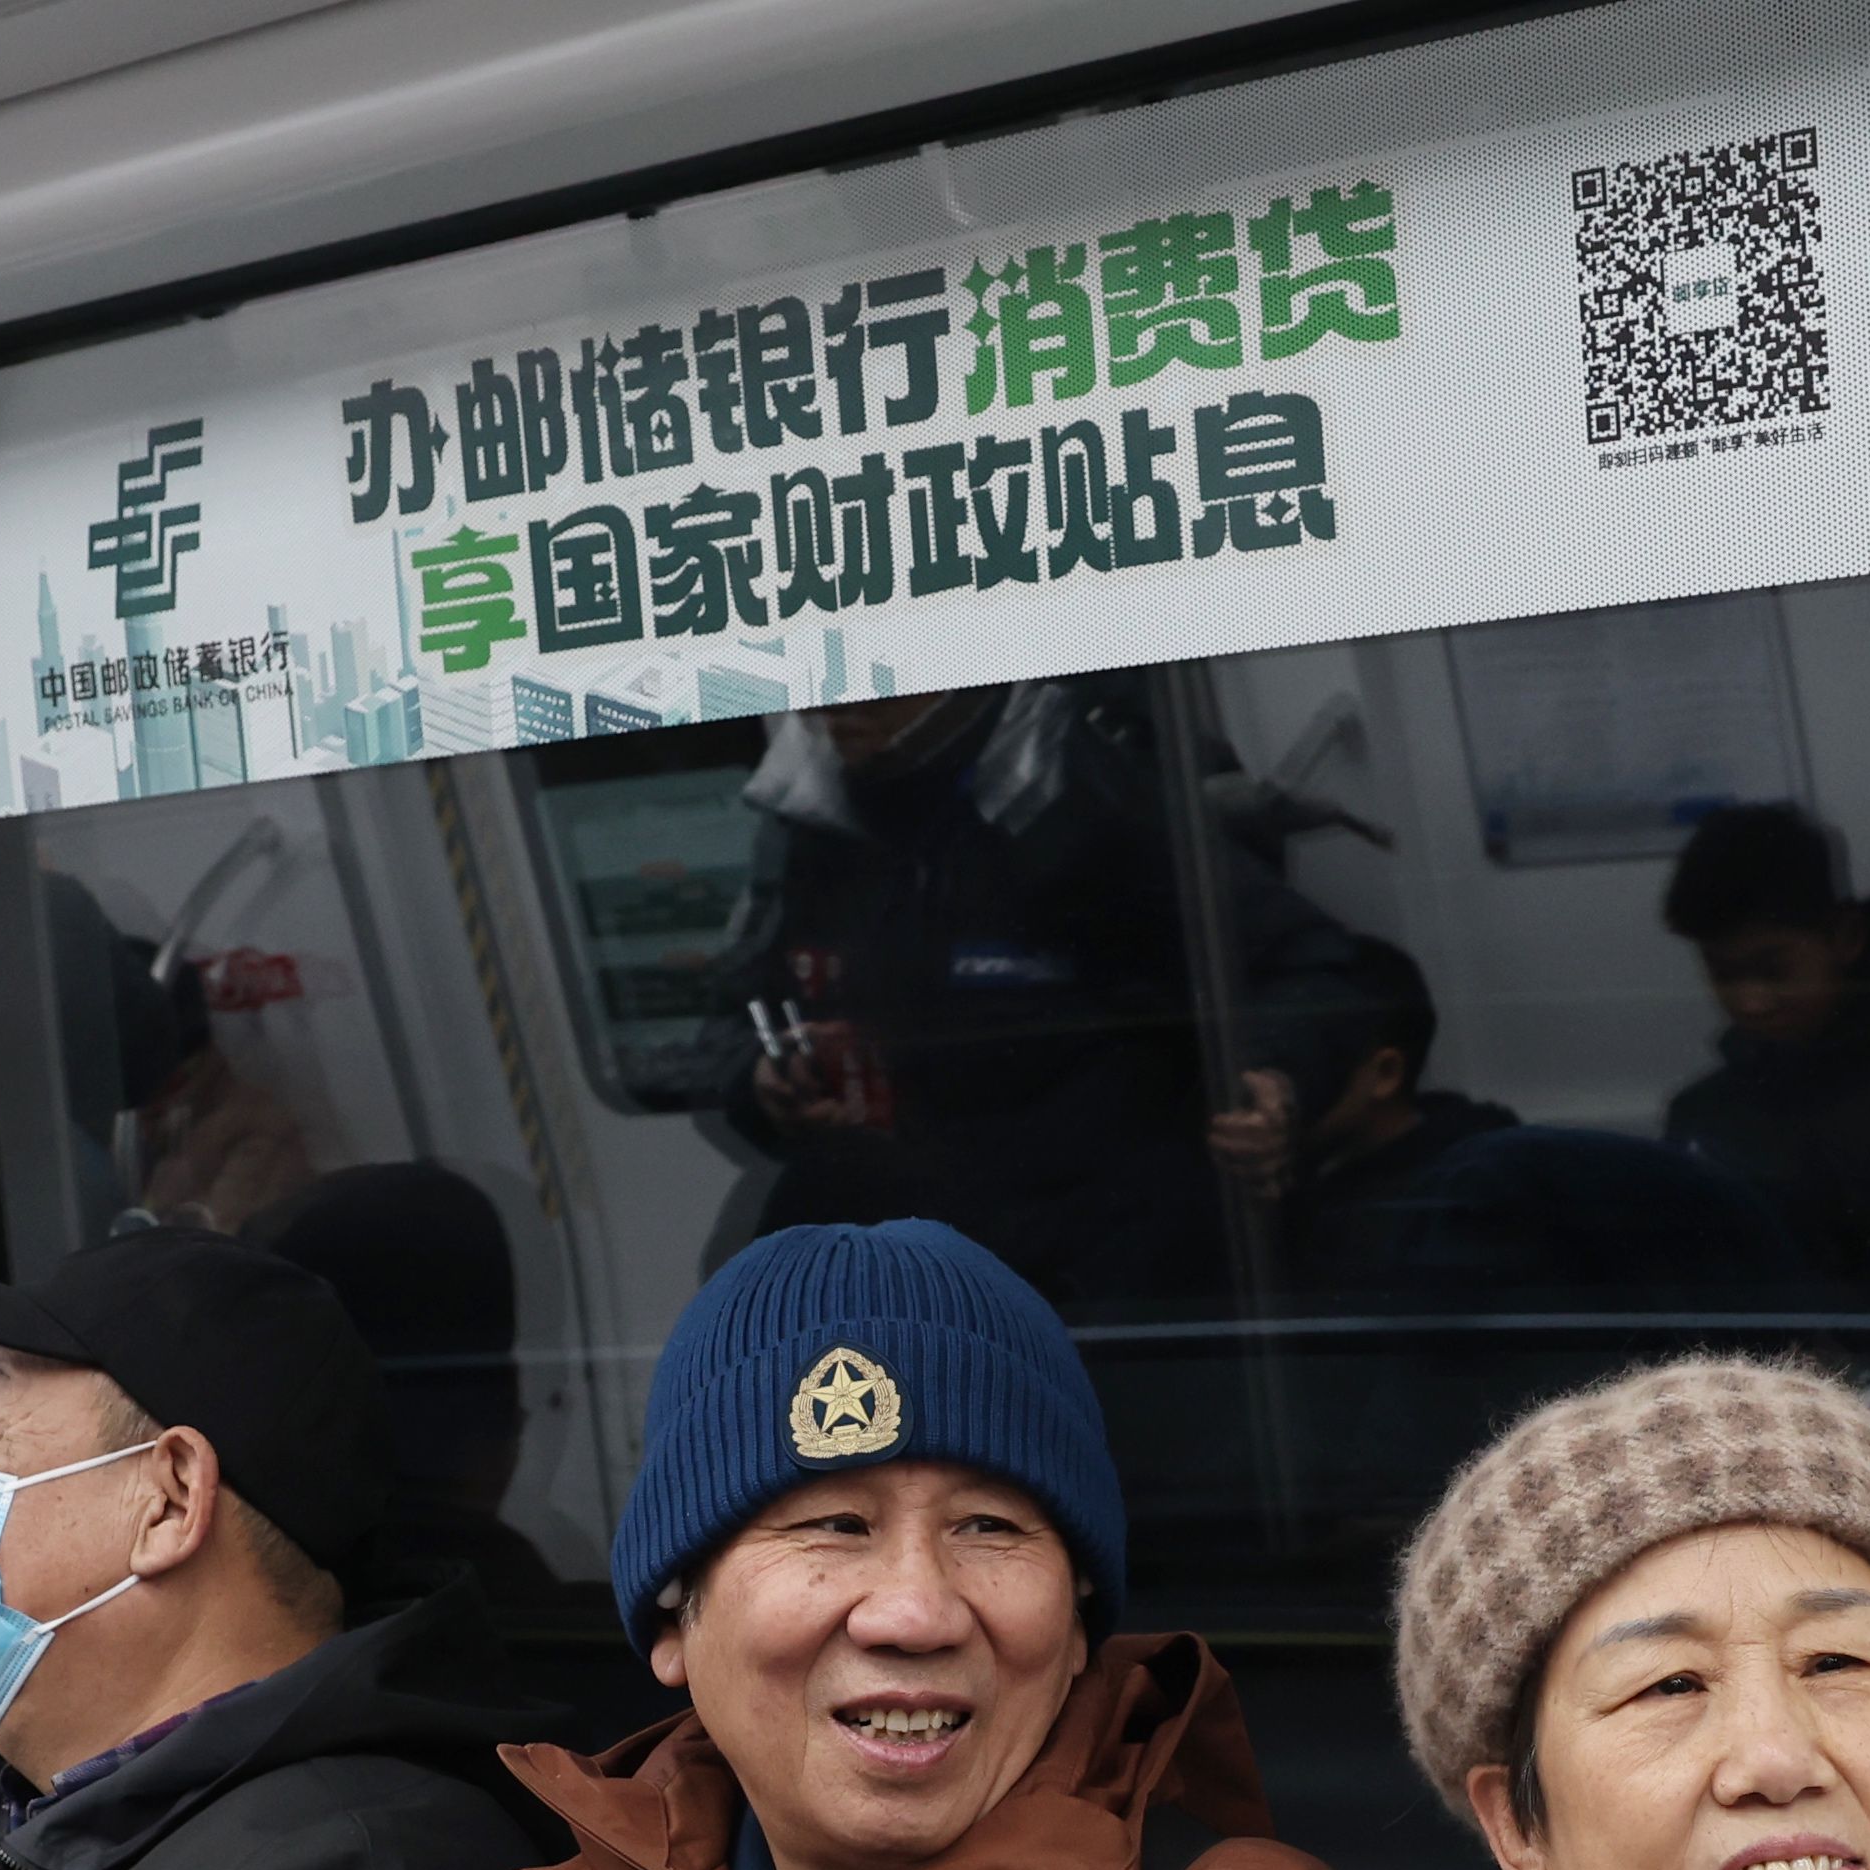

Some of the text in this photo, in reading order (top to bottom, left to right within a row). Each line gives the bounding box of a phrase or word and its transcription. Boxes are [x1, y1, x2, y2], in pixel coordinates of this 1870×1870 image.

[341, 179, 1402, 524] 办邮储银行消费贷
[412, 391, 1336, 675] 享国家财政贴息
[40, 631, 289, 708] 中国邮政储蓄银行
[43, 708, 101, 734] POSTAL
[105, 700, 168, 724] SAVINGS
[173, 694, 213, 714] BANK
[244, 679, 294, 702] CHINA
